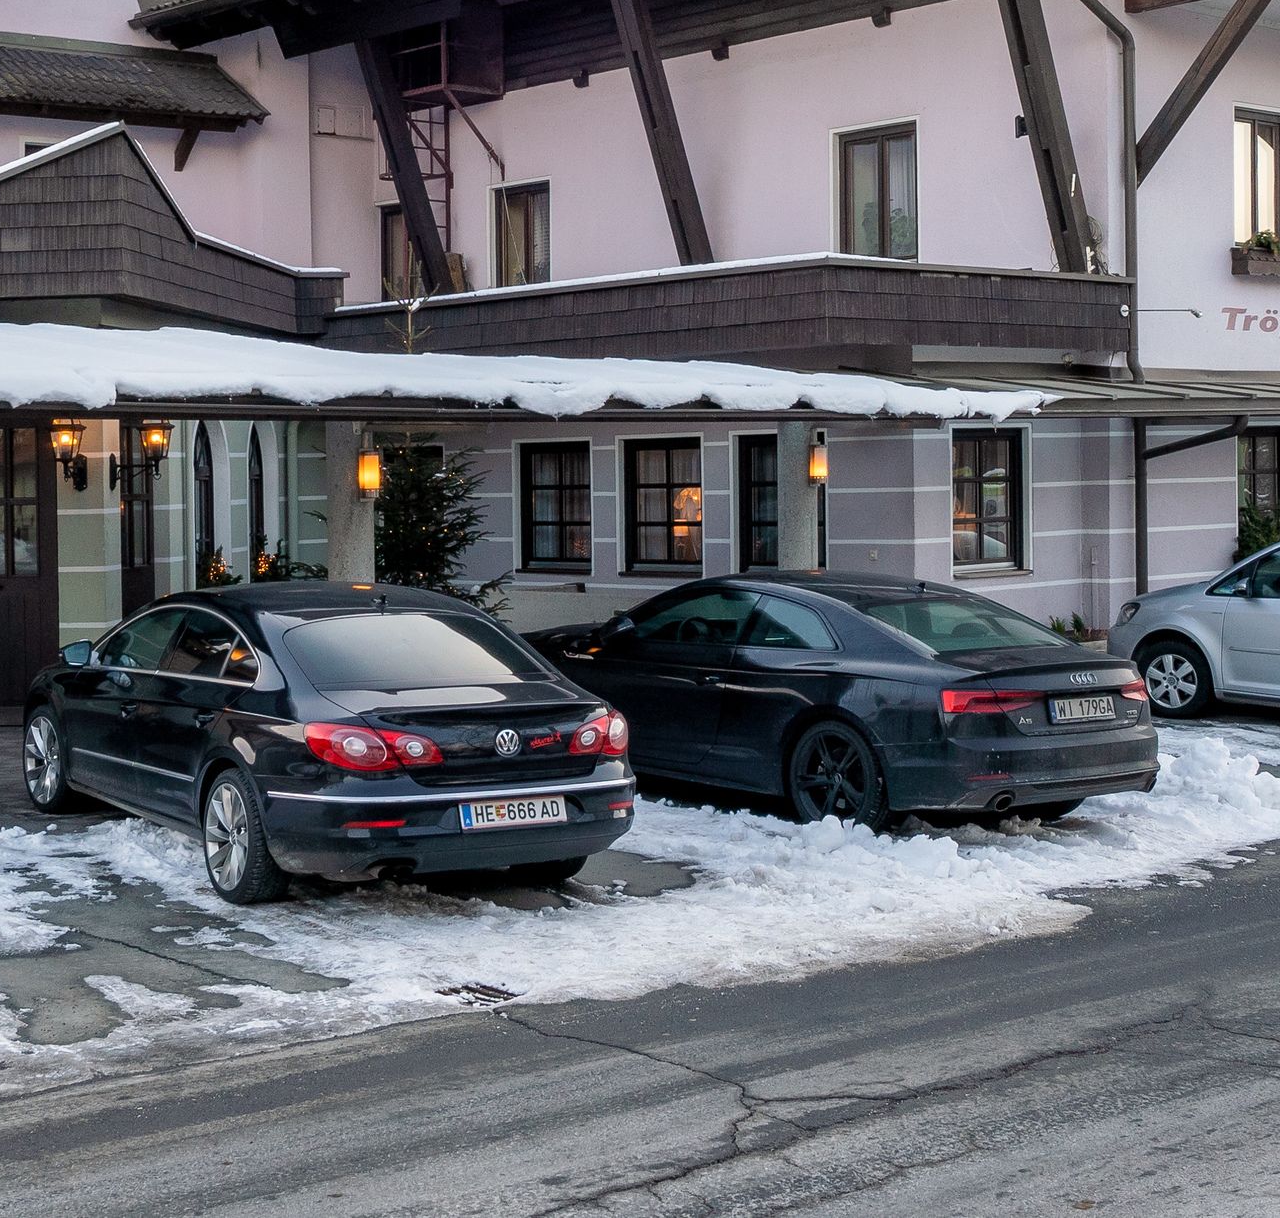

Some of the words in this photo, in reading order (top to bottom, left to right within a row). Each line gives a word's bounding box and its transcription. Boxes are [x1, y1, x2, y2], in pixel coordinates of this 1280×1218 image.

[1057, 701, 1073, 718] WI
[1078, 697, 1114, 716] 179GA
[1018, 716, 1033, 725] A5
[474, 804, 496, 824] HE
[507, 801, 536, 821] 666
[541, 799, 561, 818] AD
